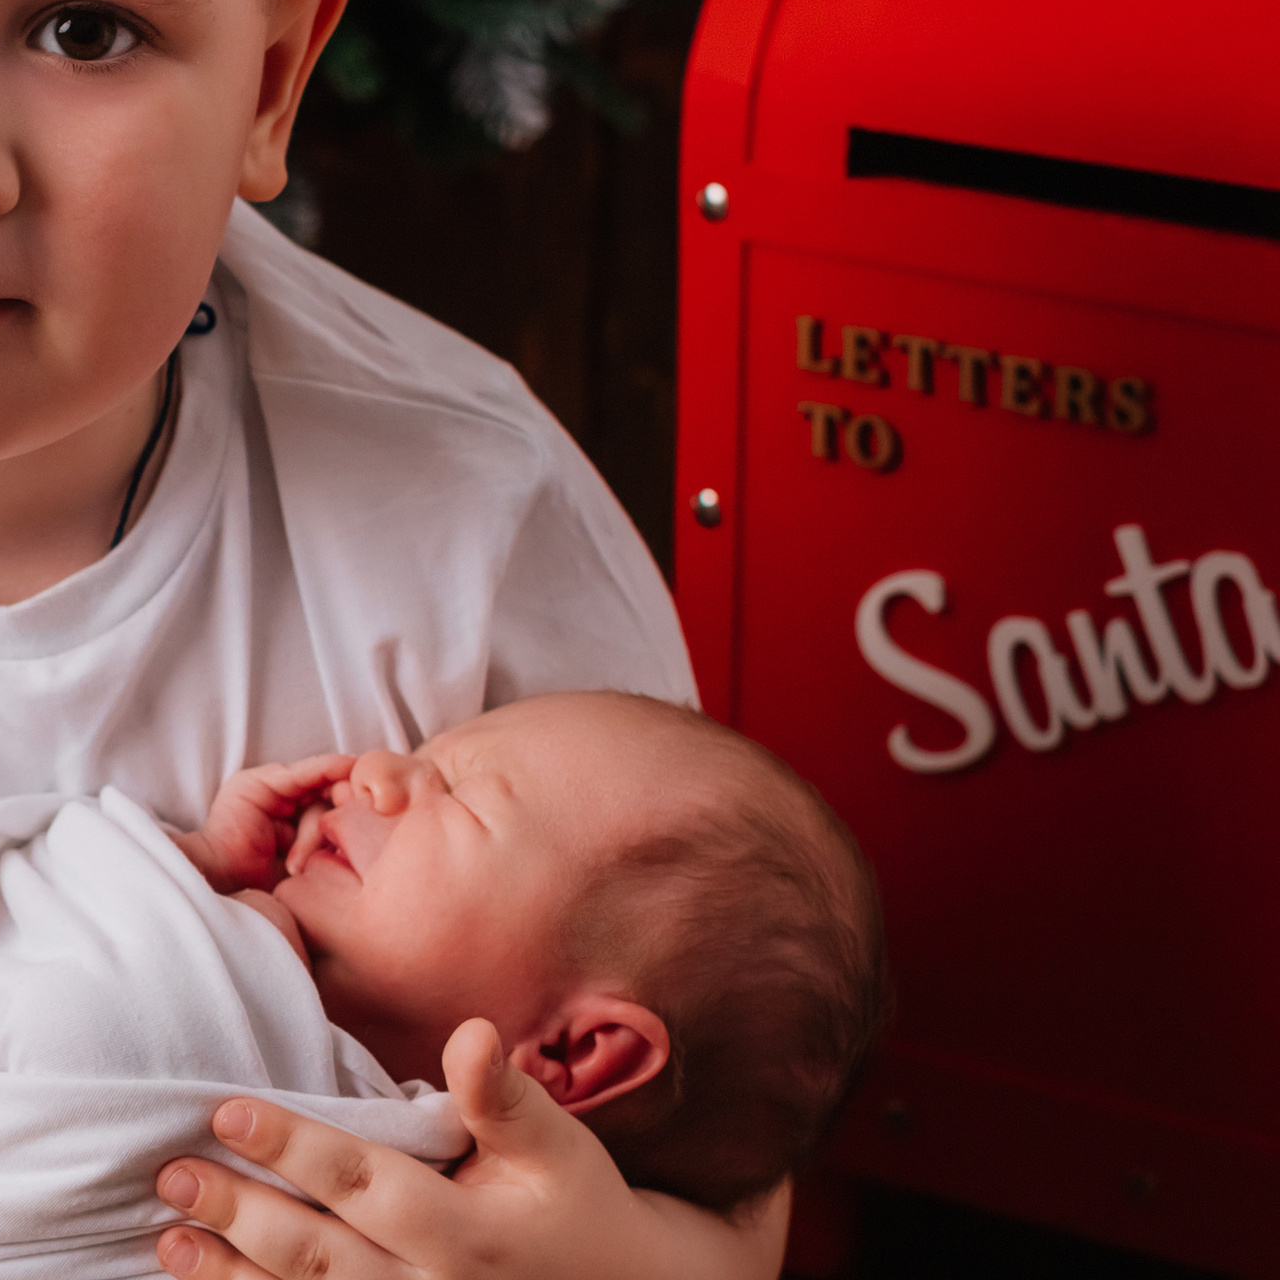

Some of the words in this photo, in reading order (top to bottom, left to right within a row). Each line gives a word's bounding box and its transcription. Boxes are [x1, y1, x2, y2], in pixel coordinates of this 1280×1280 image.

[795, 314, 1152, 433] LETTERS
[797, 400, 901, 473] TO
[854, 524, 1280, 774] Santa
